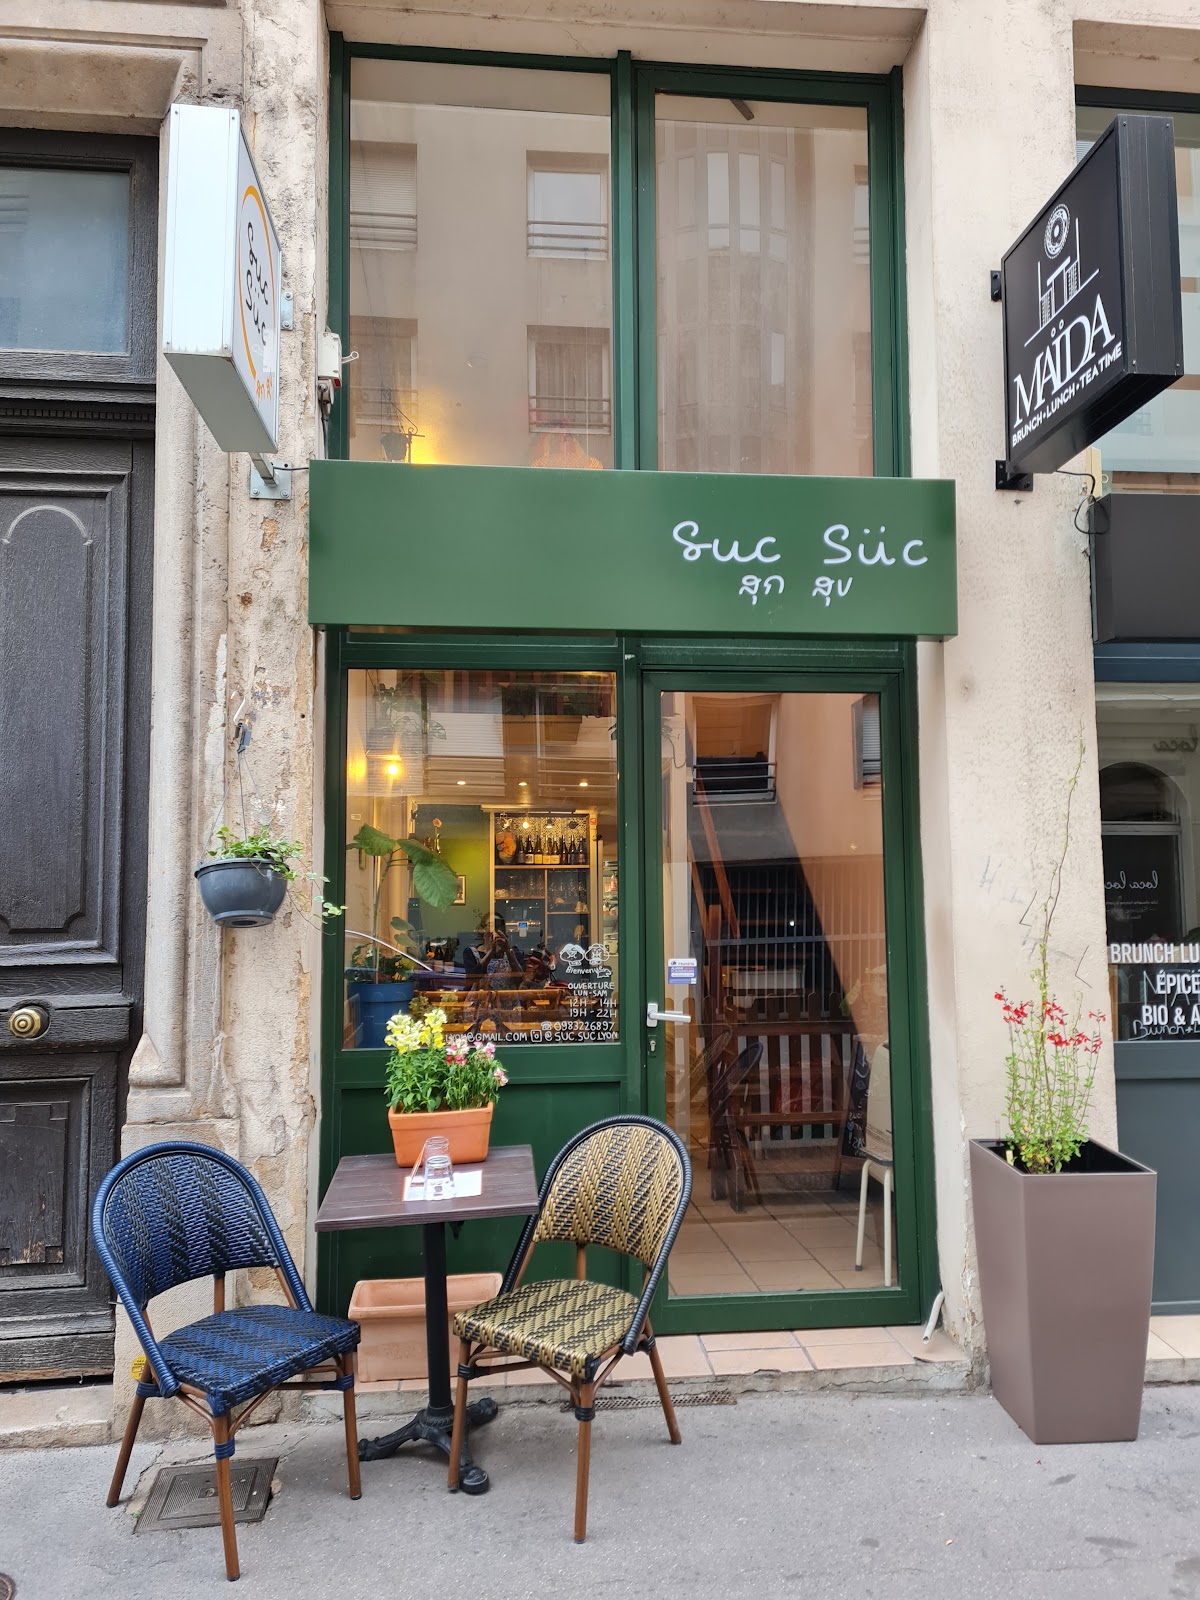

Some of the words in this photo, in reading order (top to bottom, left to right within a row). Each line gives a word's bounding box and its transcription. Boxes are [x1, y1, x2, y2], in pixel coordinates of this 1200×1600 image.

[1013, 293, 1116, 429] MAÏDA
[1079, 365, 1099, 391] TEA
[1097, 341, 1122, 369] TIME
[672, 520, 781, 563] Suc
[823, 523, 928, 566] Süc
[1110, 943, 1175, 964] BRUNCH
[567, 981, 615, 990] OUVERTURE
[569, 998, 587, 1008] 12H
[600, 998, 617, 1009] 14H
[569, 1008, 587, 1018] 19H
[596, 1008, 617, 1019] 22H
[1141, 1004, 1169, 1026] BIO
[1173, 1006, 1187, 1026] &
[553, 1021, 615, 1031] 0983226897
